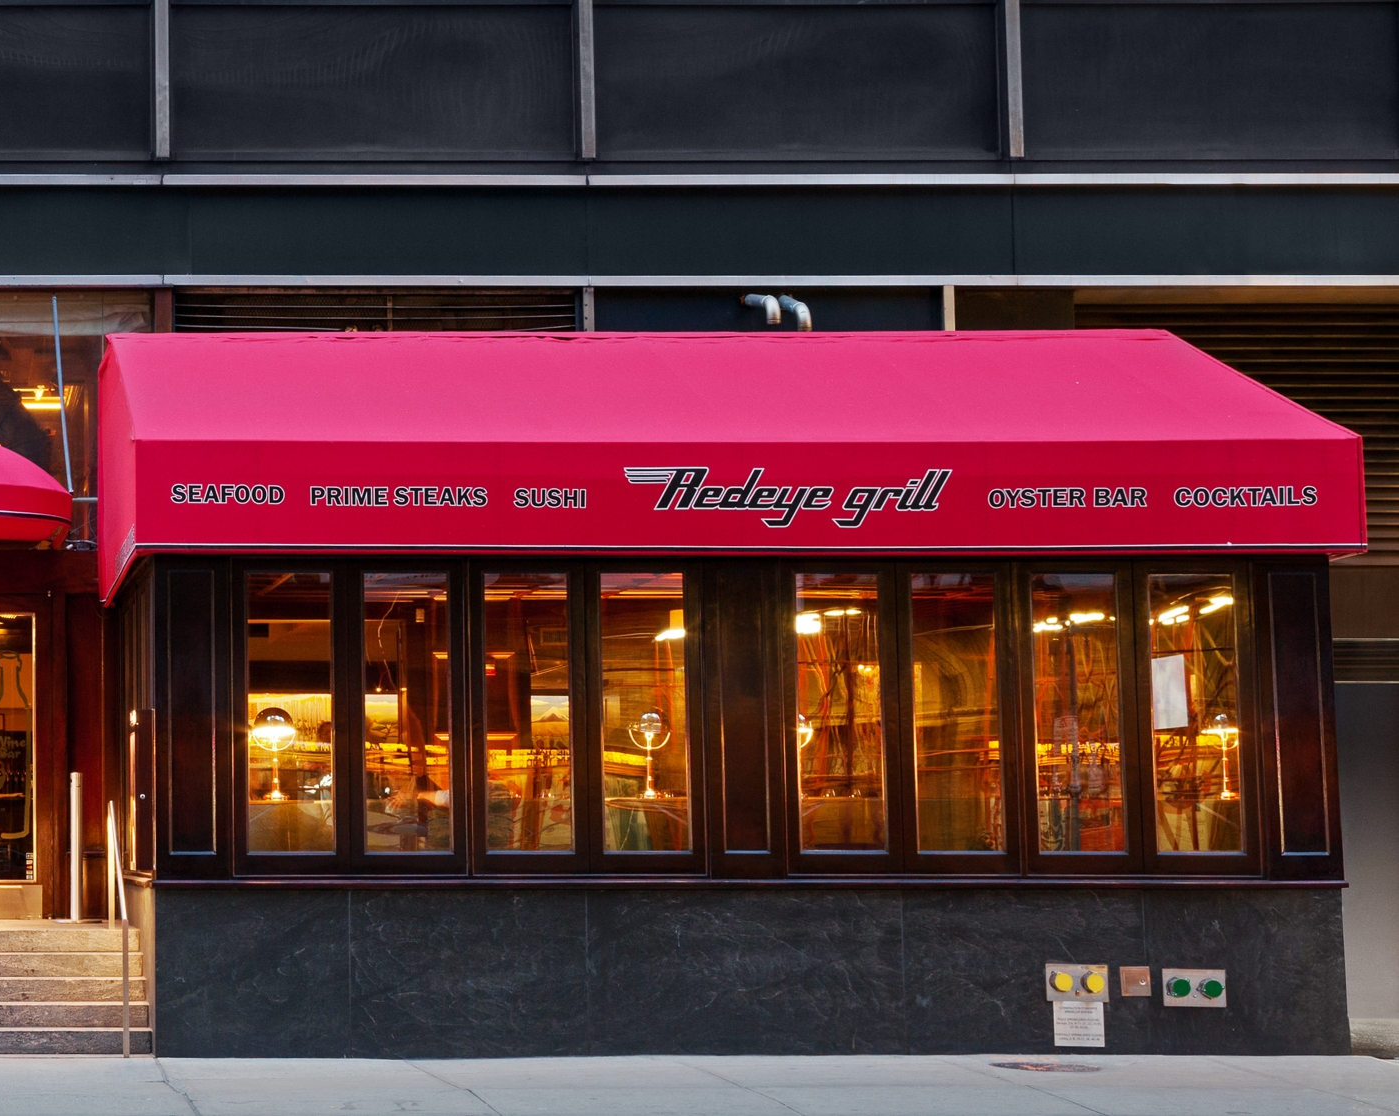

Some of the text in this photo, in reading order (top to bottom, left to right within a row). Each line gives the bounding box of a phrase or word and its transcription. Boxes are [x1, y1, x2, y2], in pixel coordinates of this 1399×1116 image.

[170, 484, 285, 504] SEAFOOD
[310, 485, 488, 508] PRIME STEAKS
[513, 488, 587, 509] SUSHI
[623, 466, 953, 528] Redeye grill
[988, 487, 1147, 509] OYSTER BAR
[1173, 486, 1317, 507] COCKTAILS
[0, 748, 21, 758] Bar
